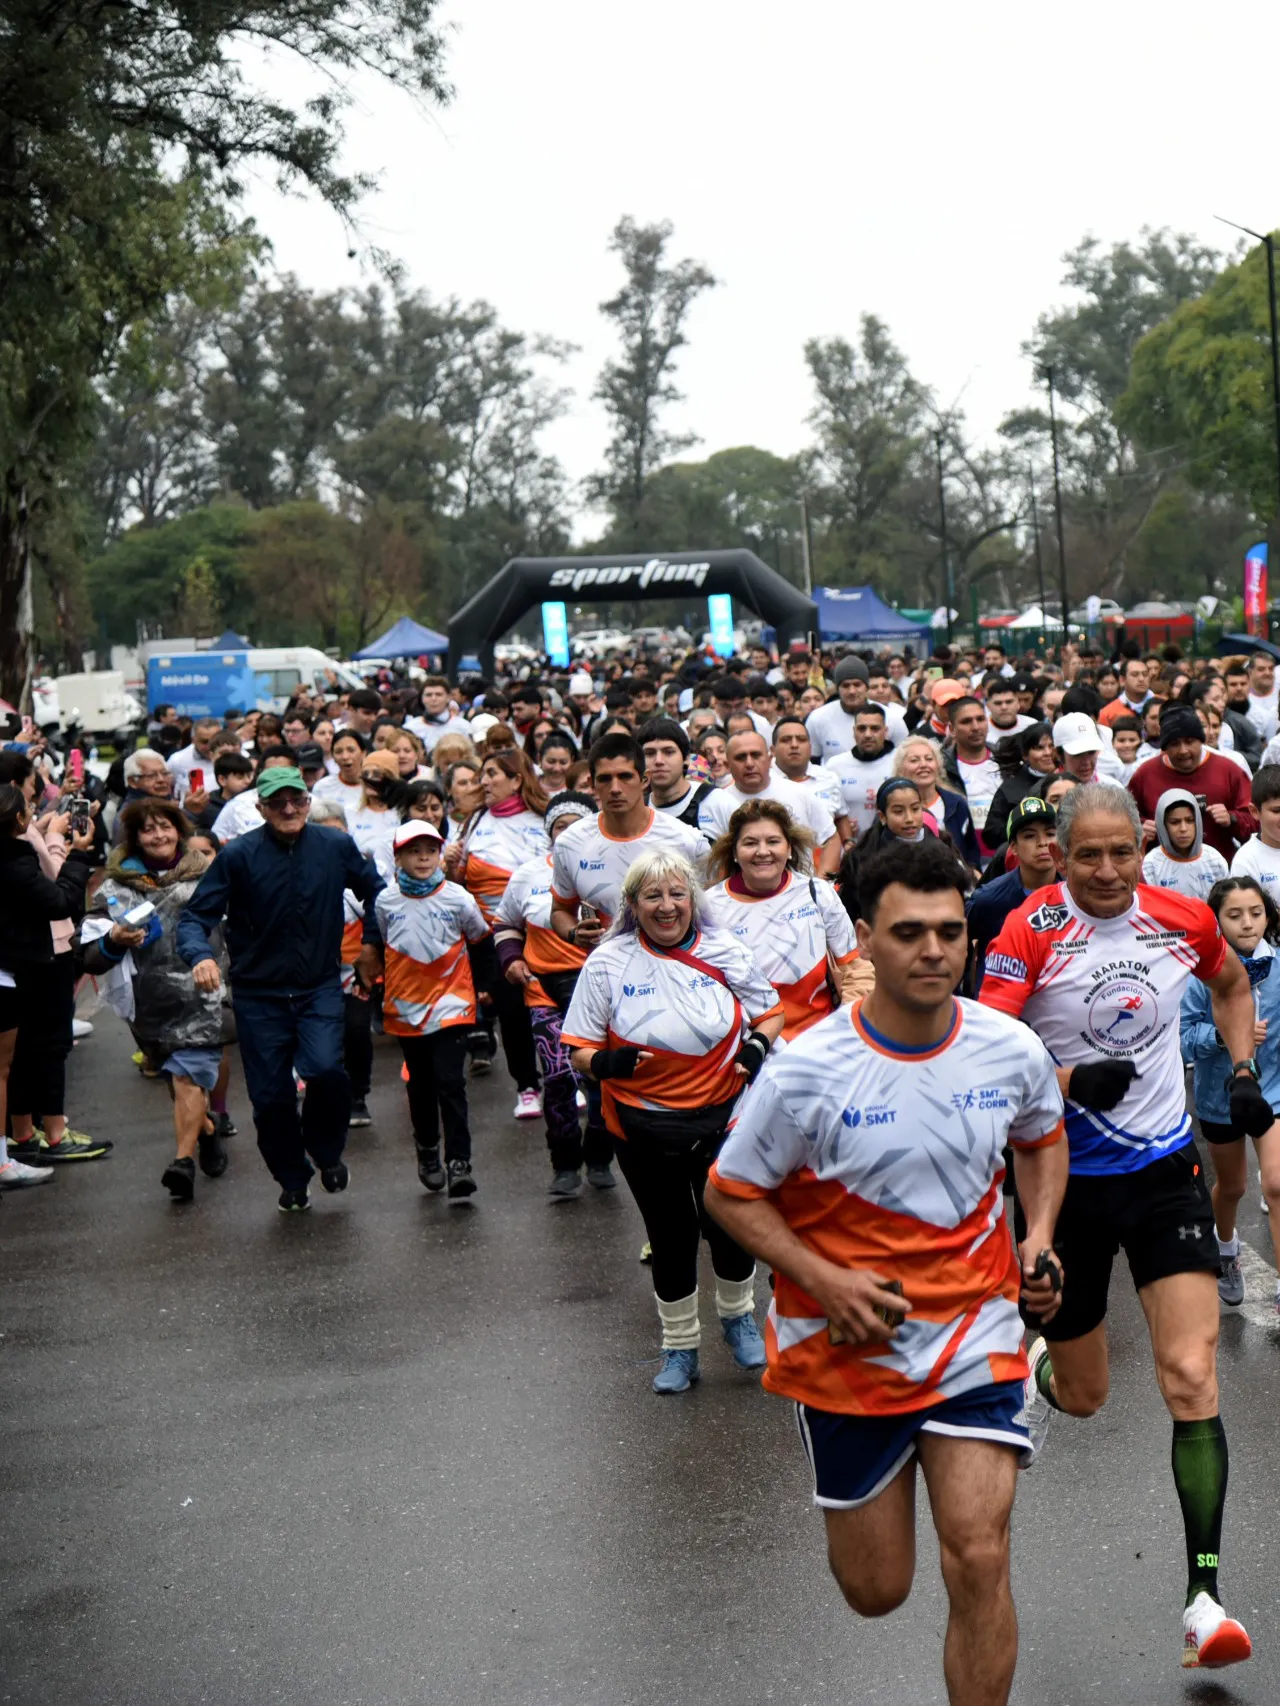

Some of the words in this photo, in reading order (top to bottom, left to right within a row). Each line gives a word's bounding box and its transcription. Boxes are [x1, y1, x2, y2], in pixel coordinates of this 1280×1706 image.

[1092, 960, 1150, 982] MARATON
[638, 987, 656, 996] SMT
[1101, 985, 1143, 1001] Fundación
[1080, 1031, 1132, 1058] MUNICIPALIDAD
[1134, 1046, 1144, 1054] DE
[1094, 1027, 1107, 1041] Juan
[1107, 1036, 1129, 1046] Pablo
[979, 1089, 999, 1099] SMT
[979, 1099, 1009, 1110] CORRE
[866, 1110, 897, 1126] SMT
